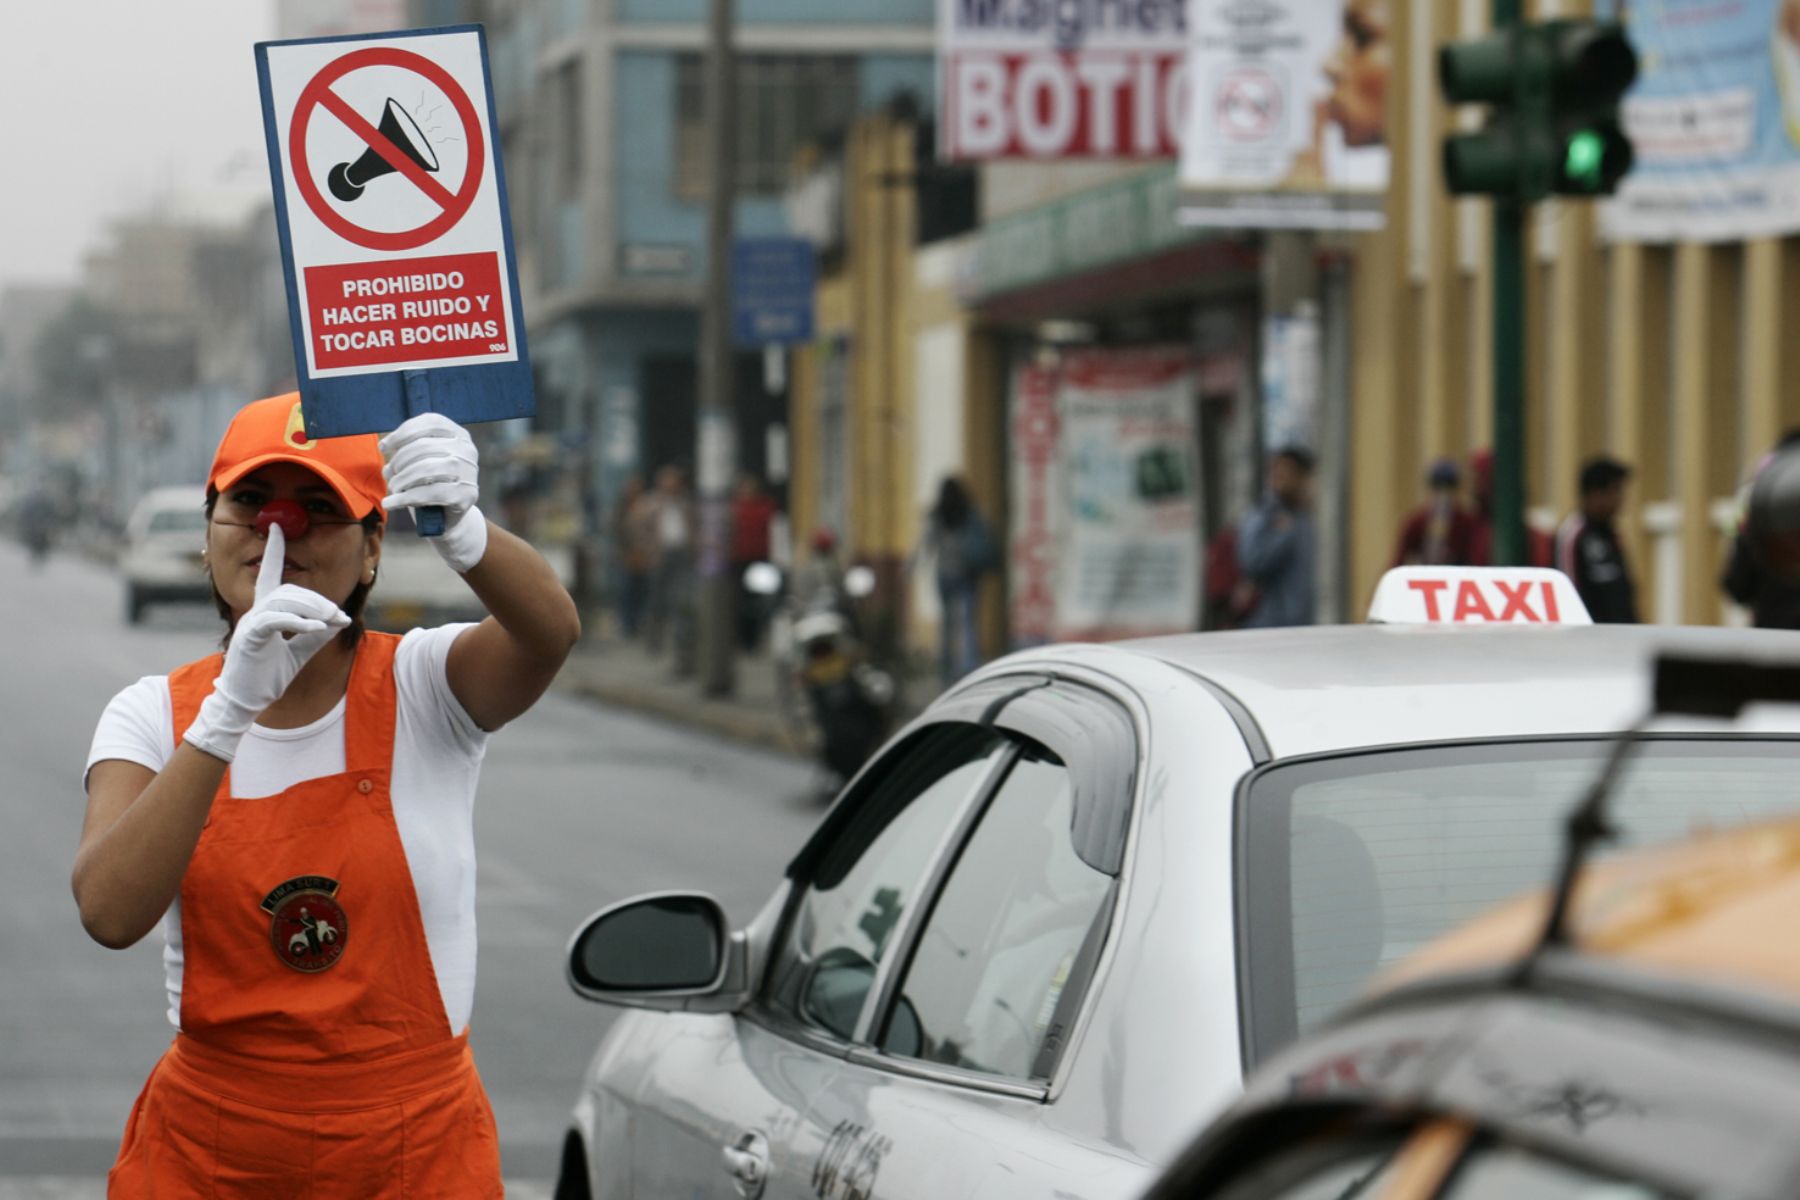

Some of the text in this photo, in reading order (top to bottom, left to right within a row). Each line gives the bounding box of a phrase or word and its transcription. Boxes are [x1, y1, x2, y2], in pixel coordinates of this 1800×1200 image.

[342, 271, 464, 298] PROHIBIDO
[322, 294, 491, 326] HACER RUIDO Y
[320, 320, 499, 352] TOCAR BOCINAS
[1407, 579, 1561, 622] TAXI
